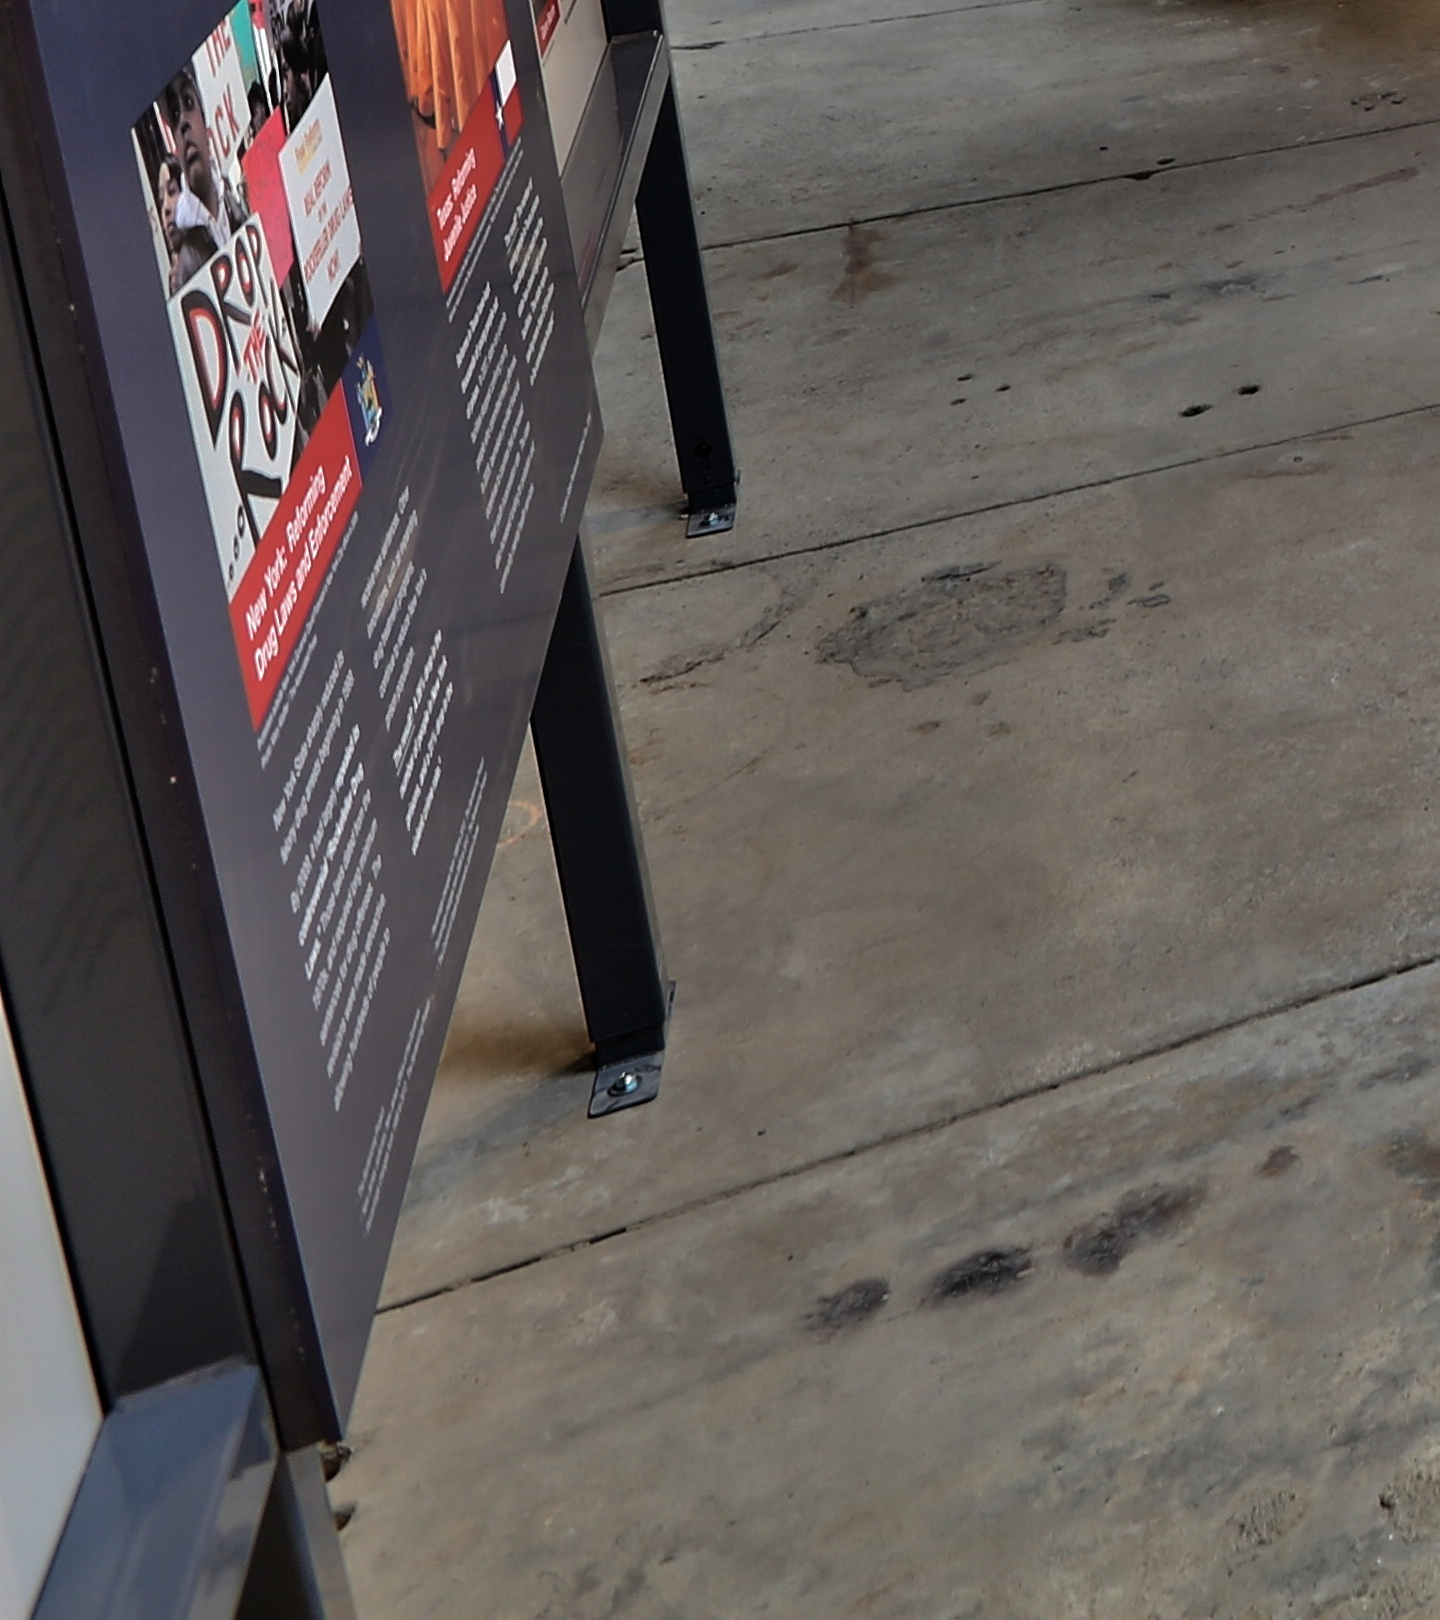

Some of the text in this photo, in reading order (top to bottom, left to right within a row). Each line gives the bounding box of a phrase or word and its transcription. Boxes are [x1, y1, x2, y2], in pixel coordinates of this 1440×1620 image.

[181, 225, 267, 450] DROP
[246, 466, 325, 640] New York: Reforming
[255, 455, 353, 681] Drug Laws and Enforcement
